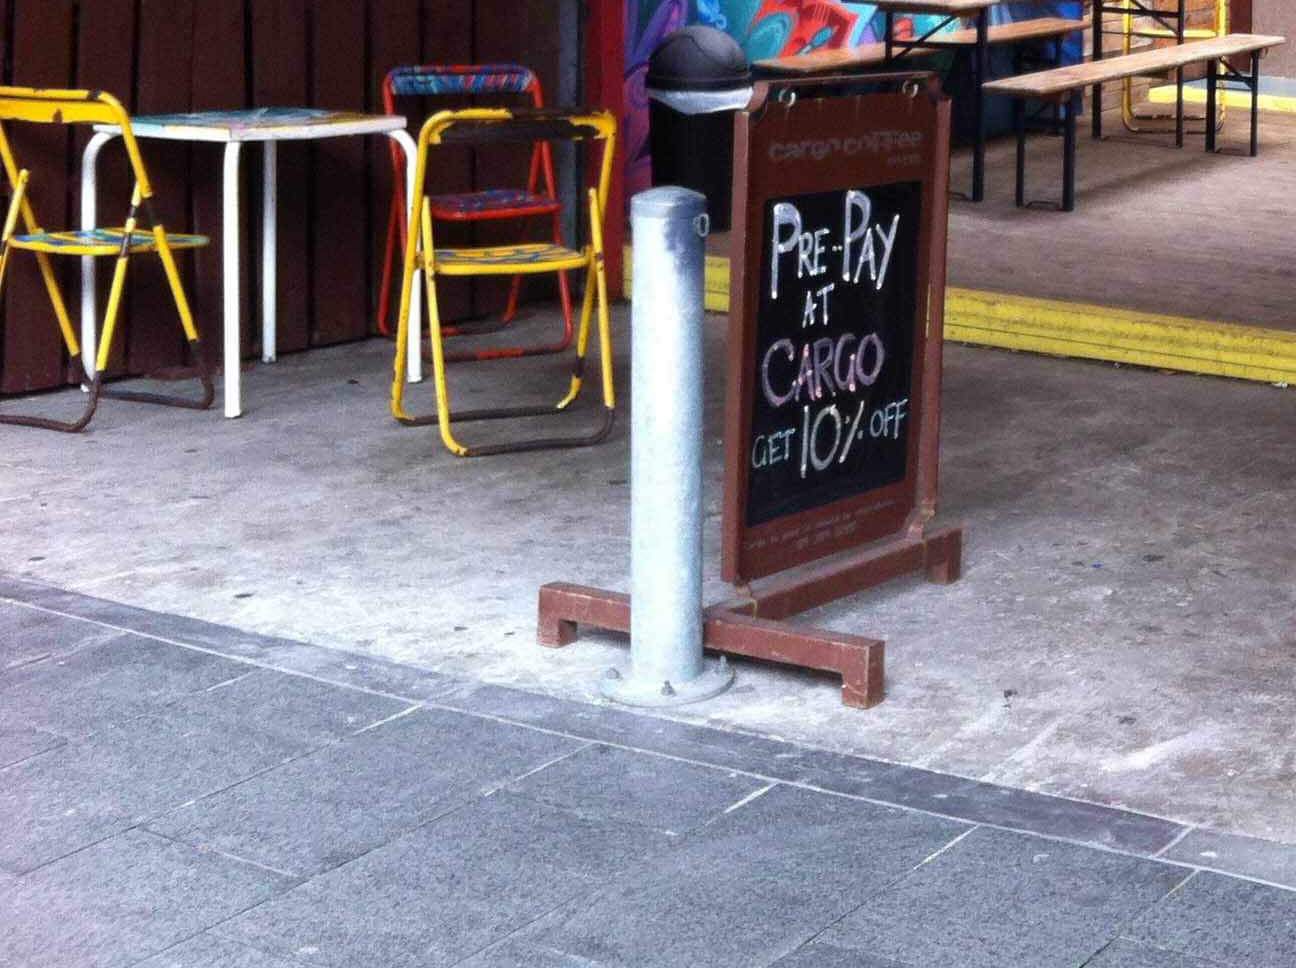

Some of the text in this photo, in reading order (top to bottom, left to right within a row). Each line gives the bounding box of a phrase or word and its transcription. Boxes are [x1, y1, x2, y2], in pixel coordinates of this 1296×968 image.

[802, 283, 835, 328] AT
[761, 332, 885, 407] CARGO
[751, 398, 909, 479] GET 10% OFF
